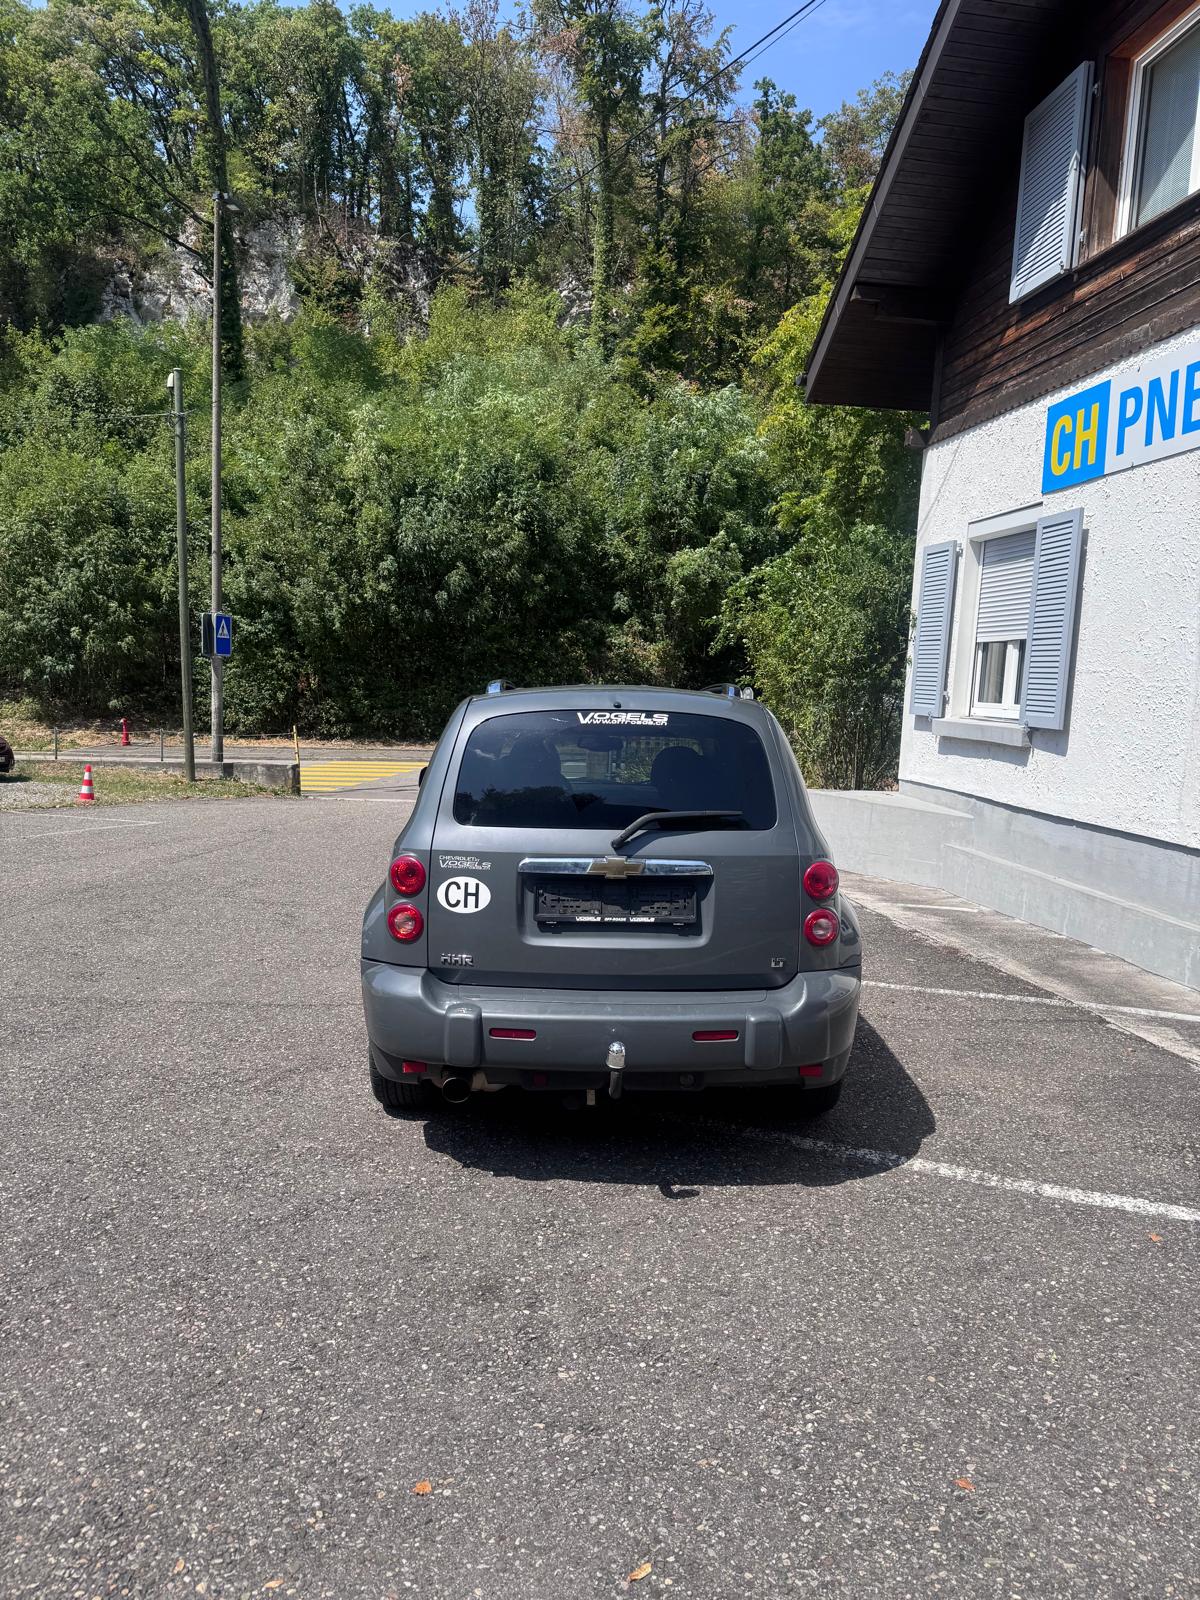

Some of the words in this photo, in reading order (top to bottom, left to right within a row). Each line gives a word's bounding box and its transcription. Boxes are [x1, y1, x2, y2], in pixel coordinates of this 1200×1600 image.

[1050, 402, 1100, 477] CH
[577, 712, 670, 725] VOGELS
[439, 860, 492, 868] VOGELS
[445, 881, 480, 908] CH
[440, 953, 474, 966] HHR
